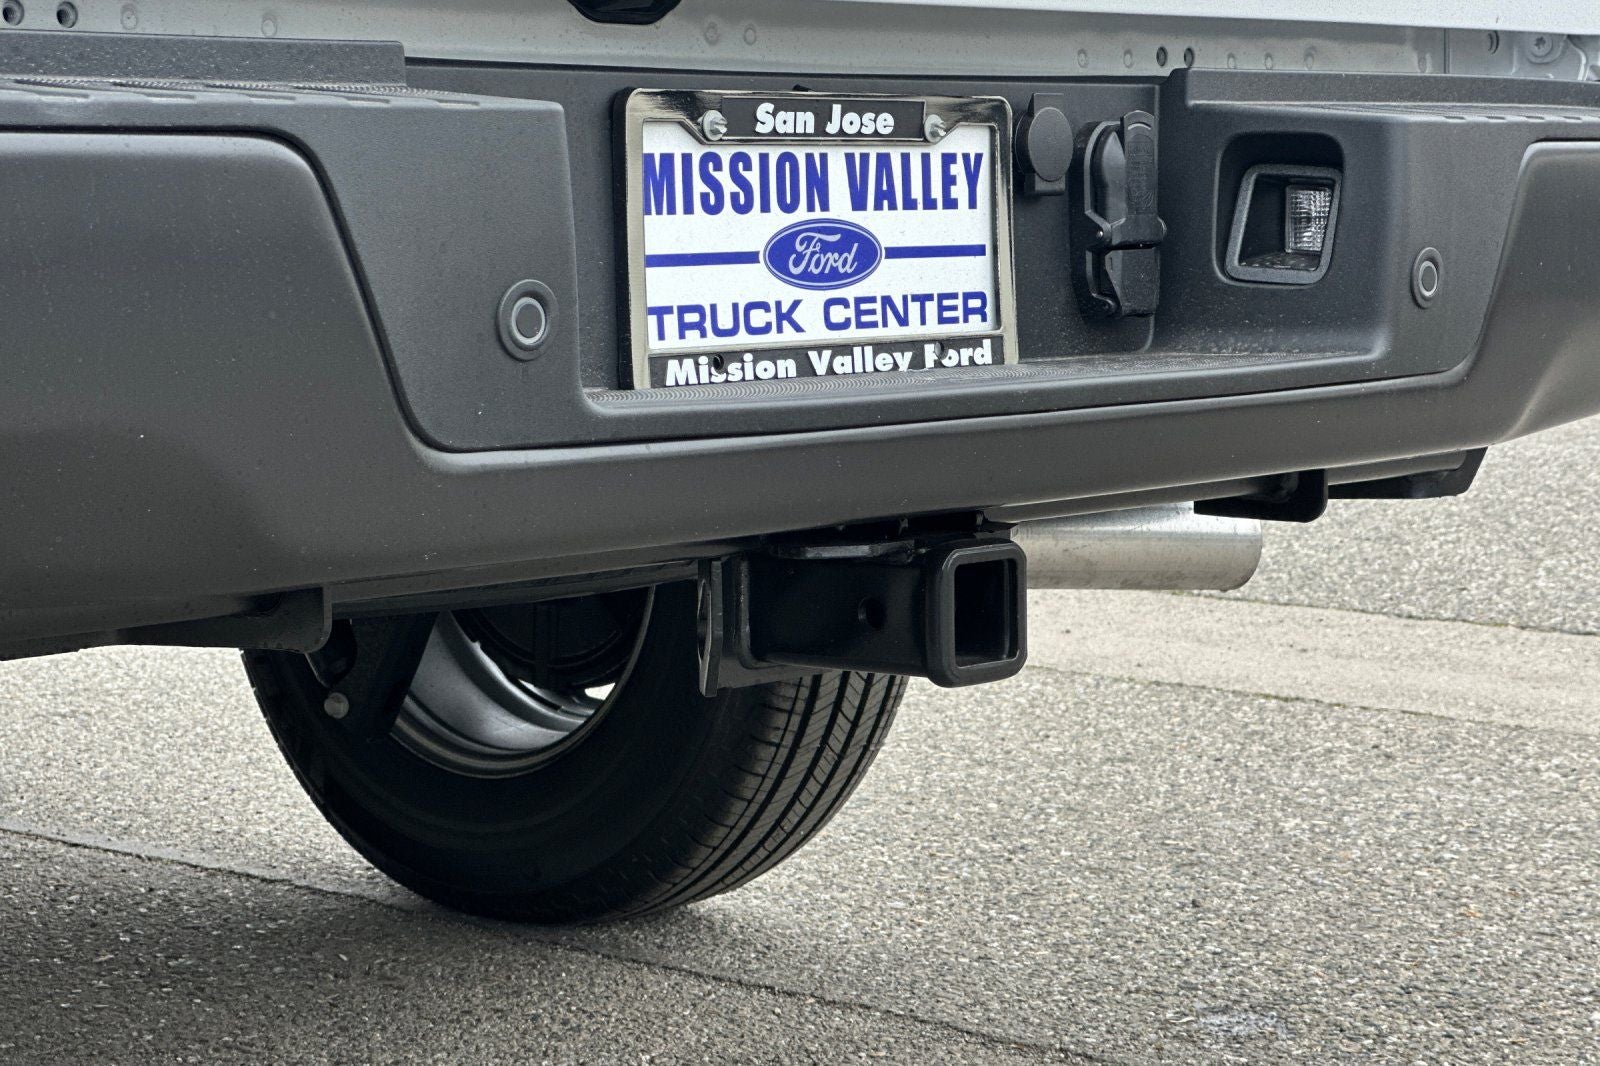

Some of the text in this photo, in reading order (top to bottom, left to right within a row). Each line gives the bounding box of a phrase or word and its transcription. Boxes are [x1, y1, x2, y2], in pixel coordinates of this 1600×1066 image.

[755, 102, 895, 135] San Jose
[643, 151, 984, 216] MISSION VALLEY
[788, 232, 858, 275] Ford
[647, 291, 988, 341] TRUCK CENTER
[807, 346, 913, 376] Valley
[924, 338, 993, 369] Ford
